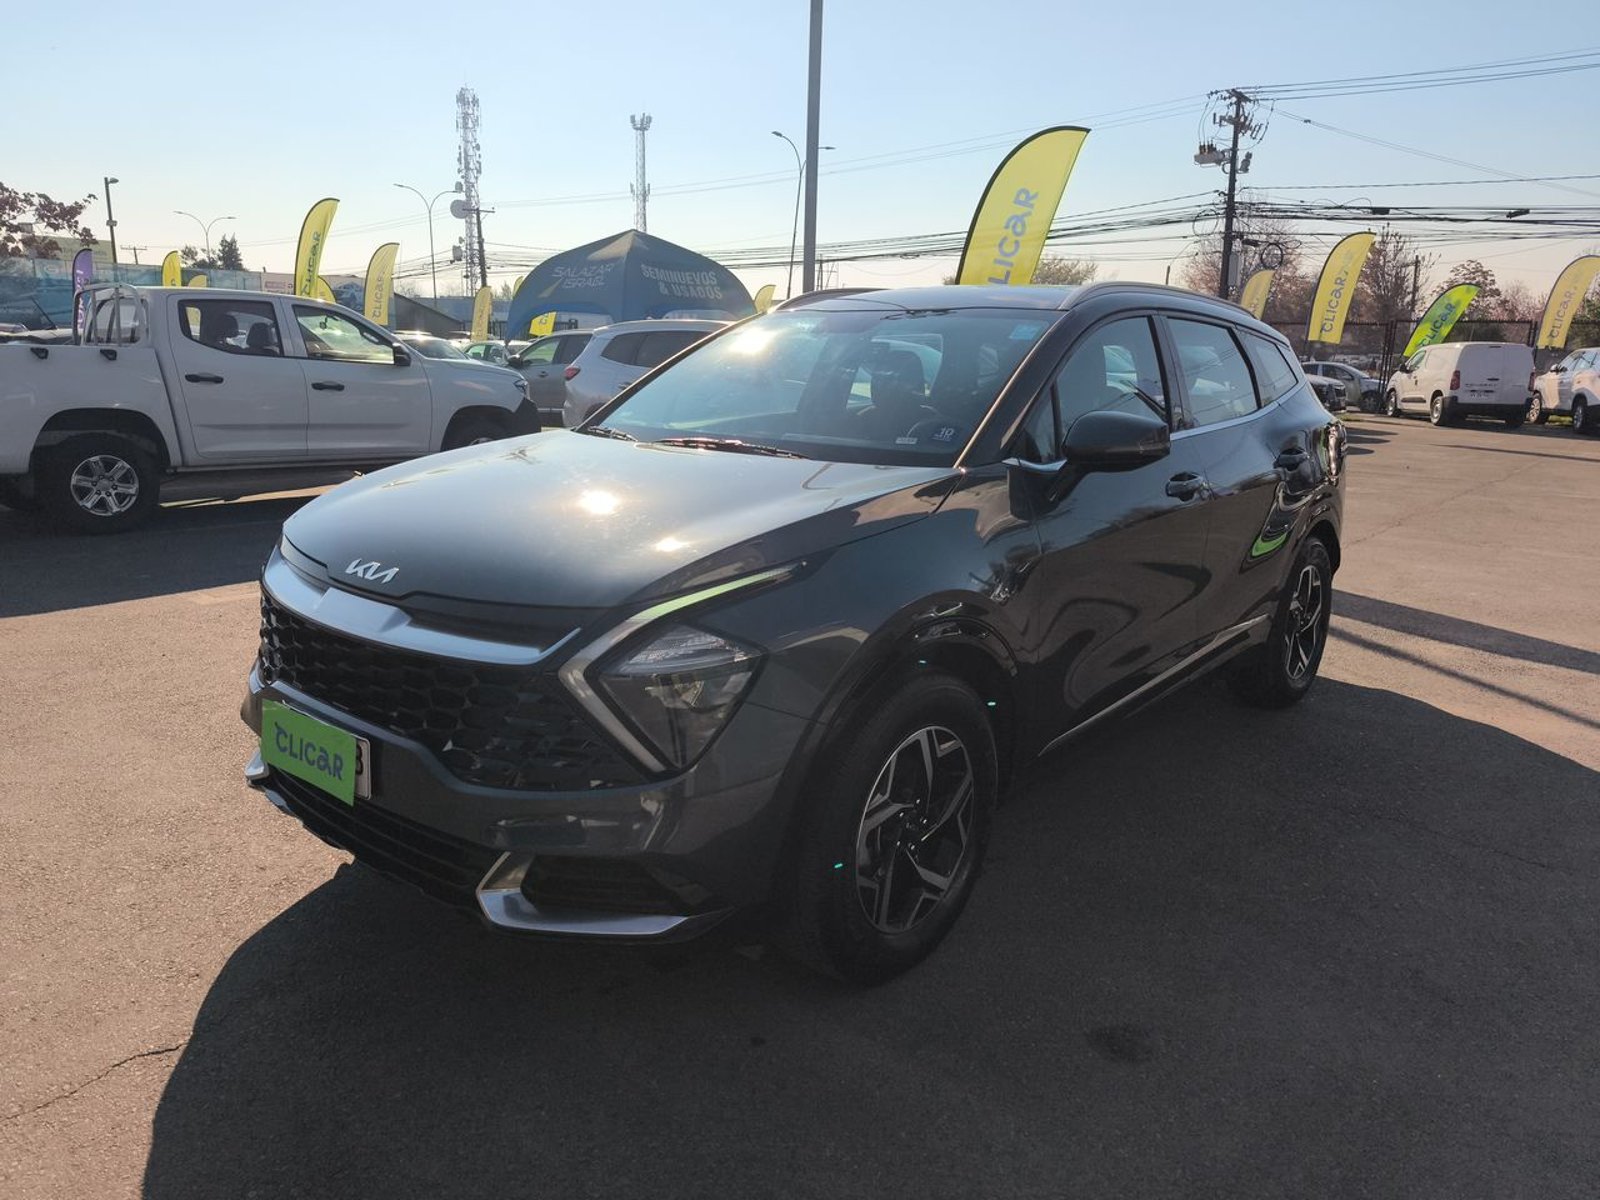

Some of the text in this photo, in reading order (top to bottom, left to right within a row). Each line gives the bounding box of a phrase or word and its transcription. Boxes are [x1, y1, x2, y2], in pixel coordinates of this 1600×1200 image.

[988, 187, 1039, 285] LICaR
[641, 264, 717, 286] SEMINUEVOS
[659, 284, 722, 300] & USADOS
[345, 558, 399, 584] KIA
